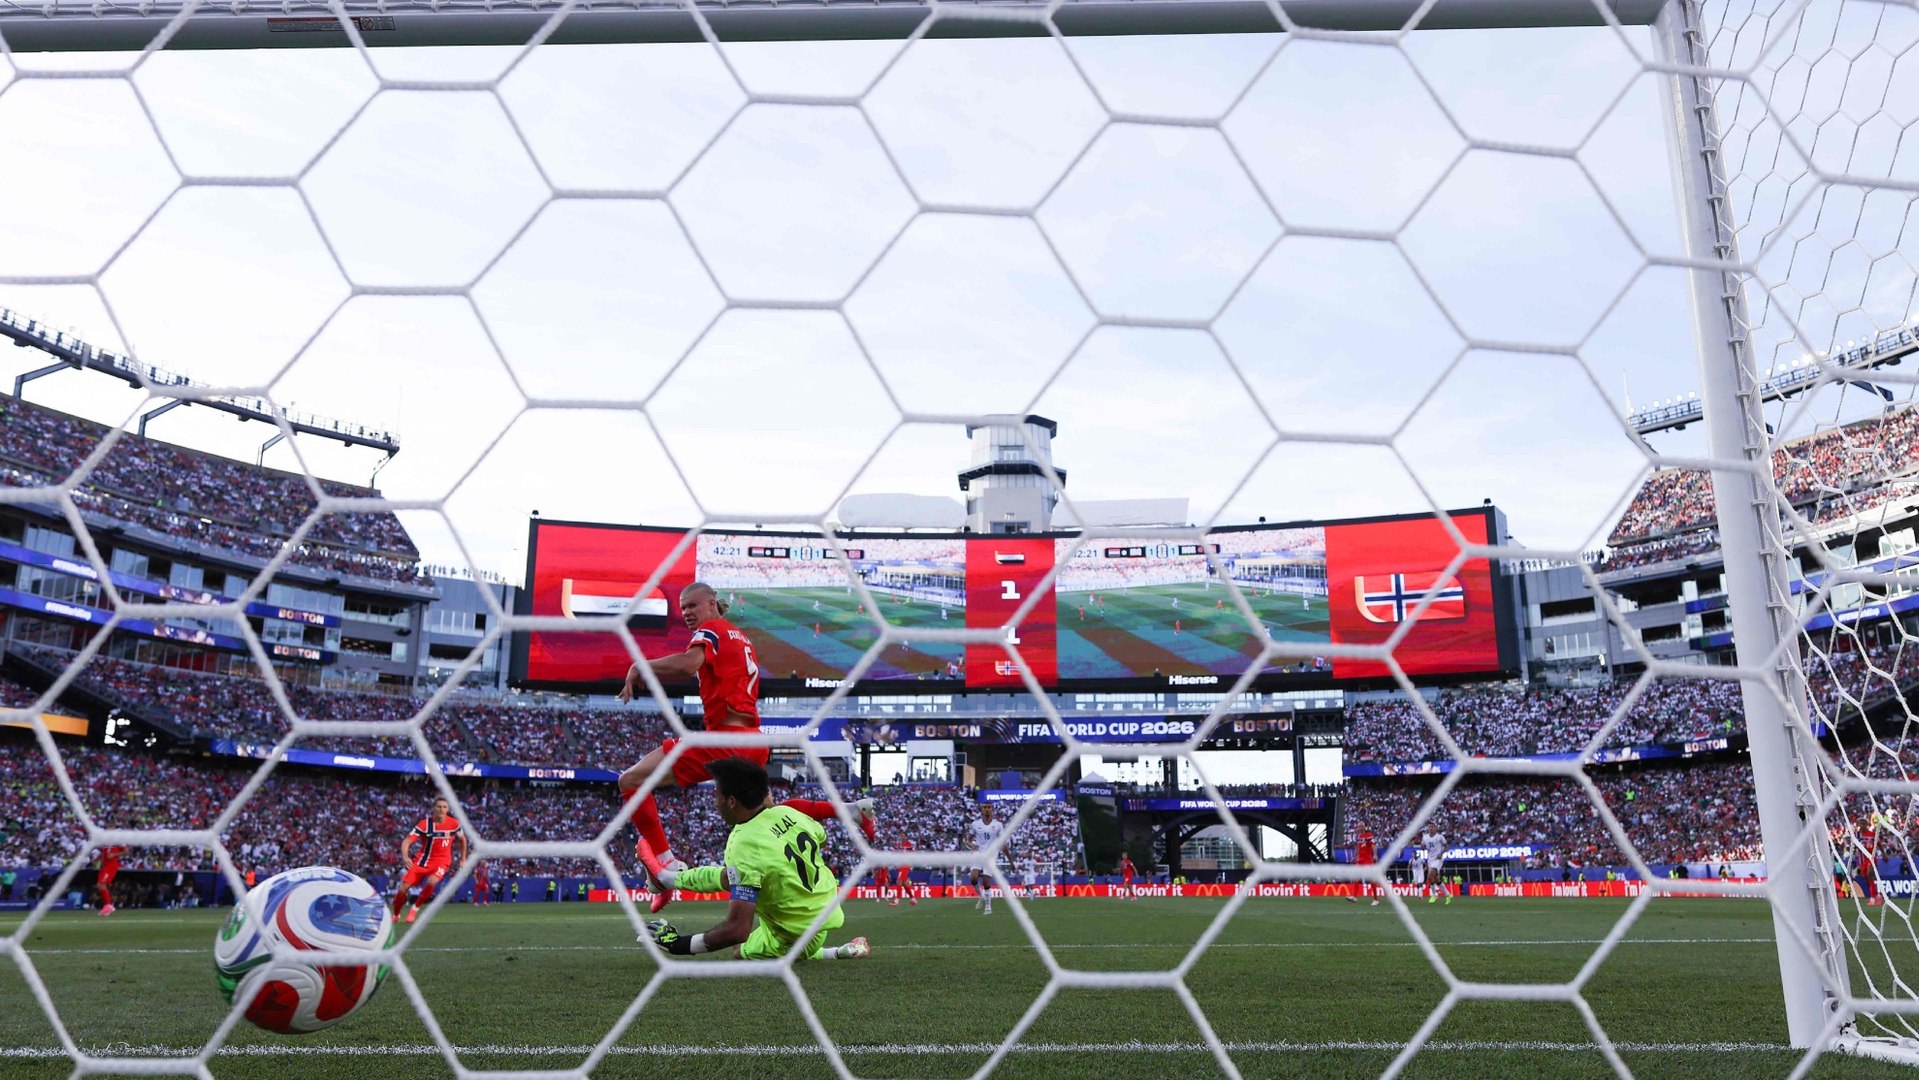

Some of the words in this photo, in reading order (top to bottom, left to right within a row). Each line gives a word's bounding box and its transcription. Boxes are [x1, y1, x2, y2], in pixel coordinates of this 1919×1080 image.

[713, 547, 740, 556] 42:21
[1073, 549, 1097, 558] 2:21
[1001, 580, 1020, 599] 1
[1168, 674, 1218, 685] Hisense
[915, 724, 981, 737] BOSTON
[1018, 724, 1051, 737] FIFA
[1108, 722, 1140, 735] CUP
[1141, 721, 1195, 734] 2026
[1684, 738, 1728, 753] BOSTON
[529, 768, 575, 779] BOSTON
[1079, 786, 1112, 796] BOSTON
[1180, 800, 1197, 808] FIFA
[1225, 800, 1241, 808] CUP
[1241, 800, 1268, 808] 2026
[1442, 848, 1476, 859] ORLD
[1476, 847, 1499, 858] CUP
[1499, 846, 1532, 858] 2026
[857, 885, 878, 899] i'm
[920, 885, 932, 899] it
[1132, 883, 1170, 897] lovin'
[1172, 883, 1183, 897] it
[1259, 883, 1297, 897] lovin'
[1299, 883, 1311, 897] it
